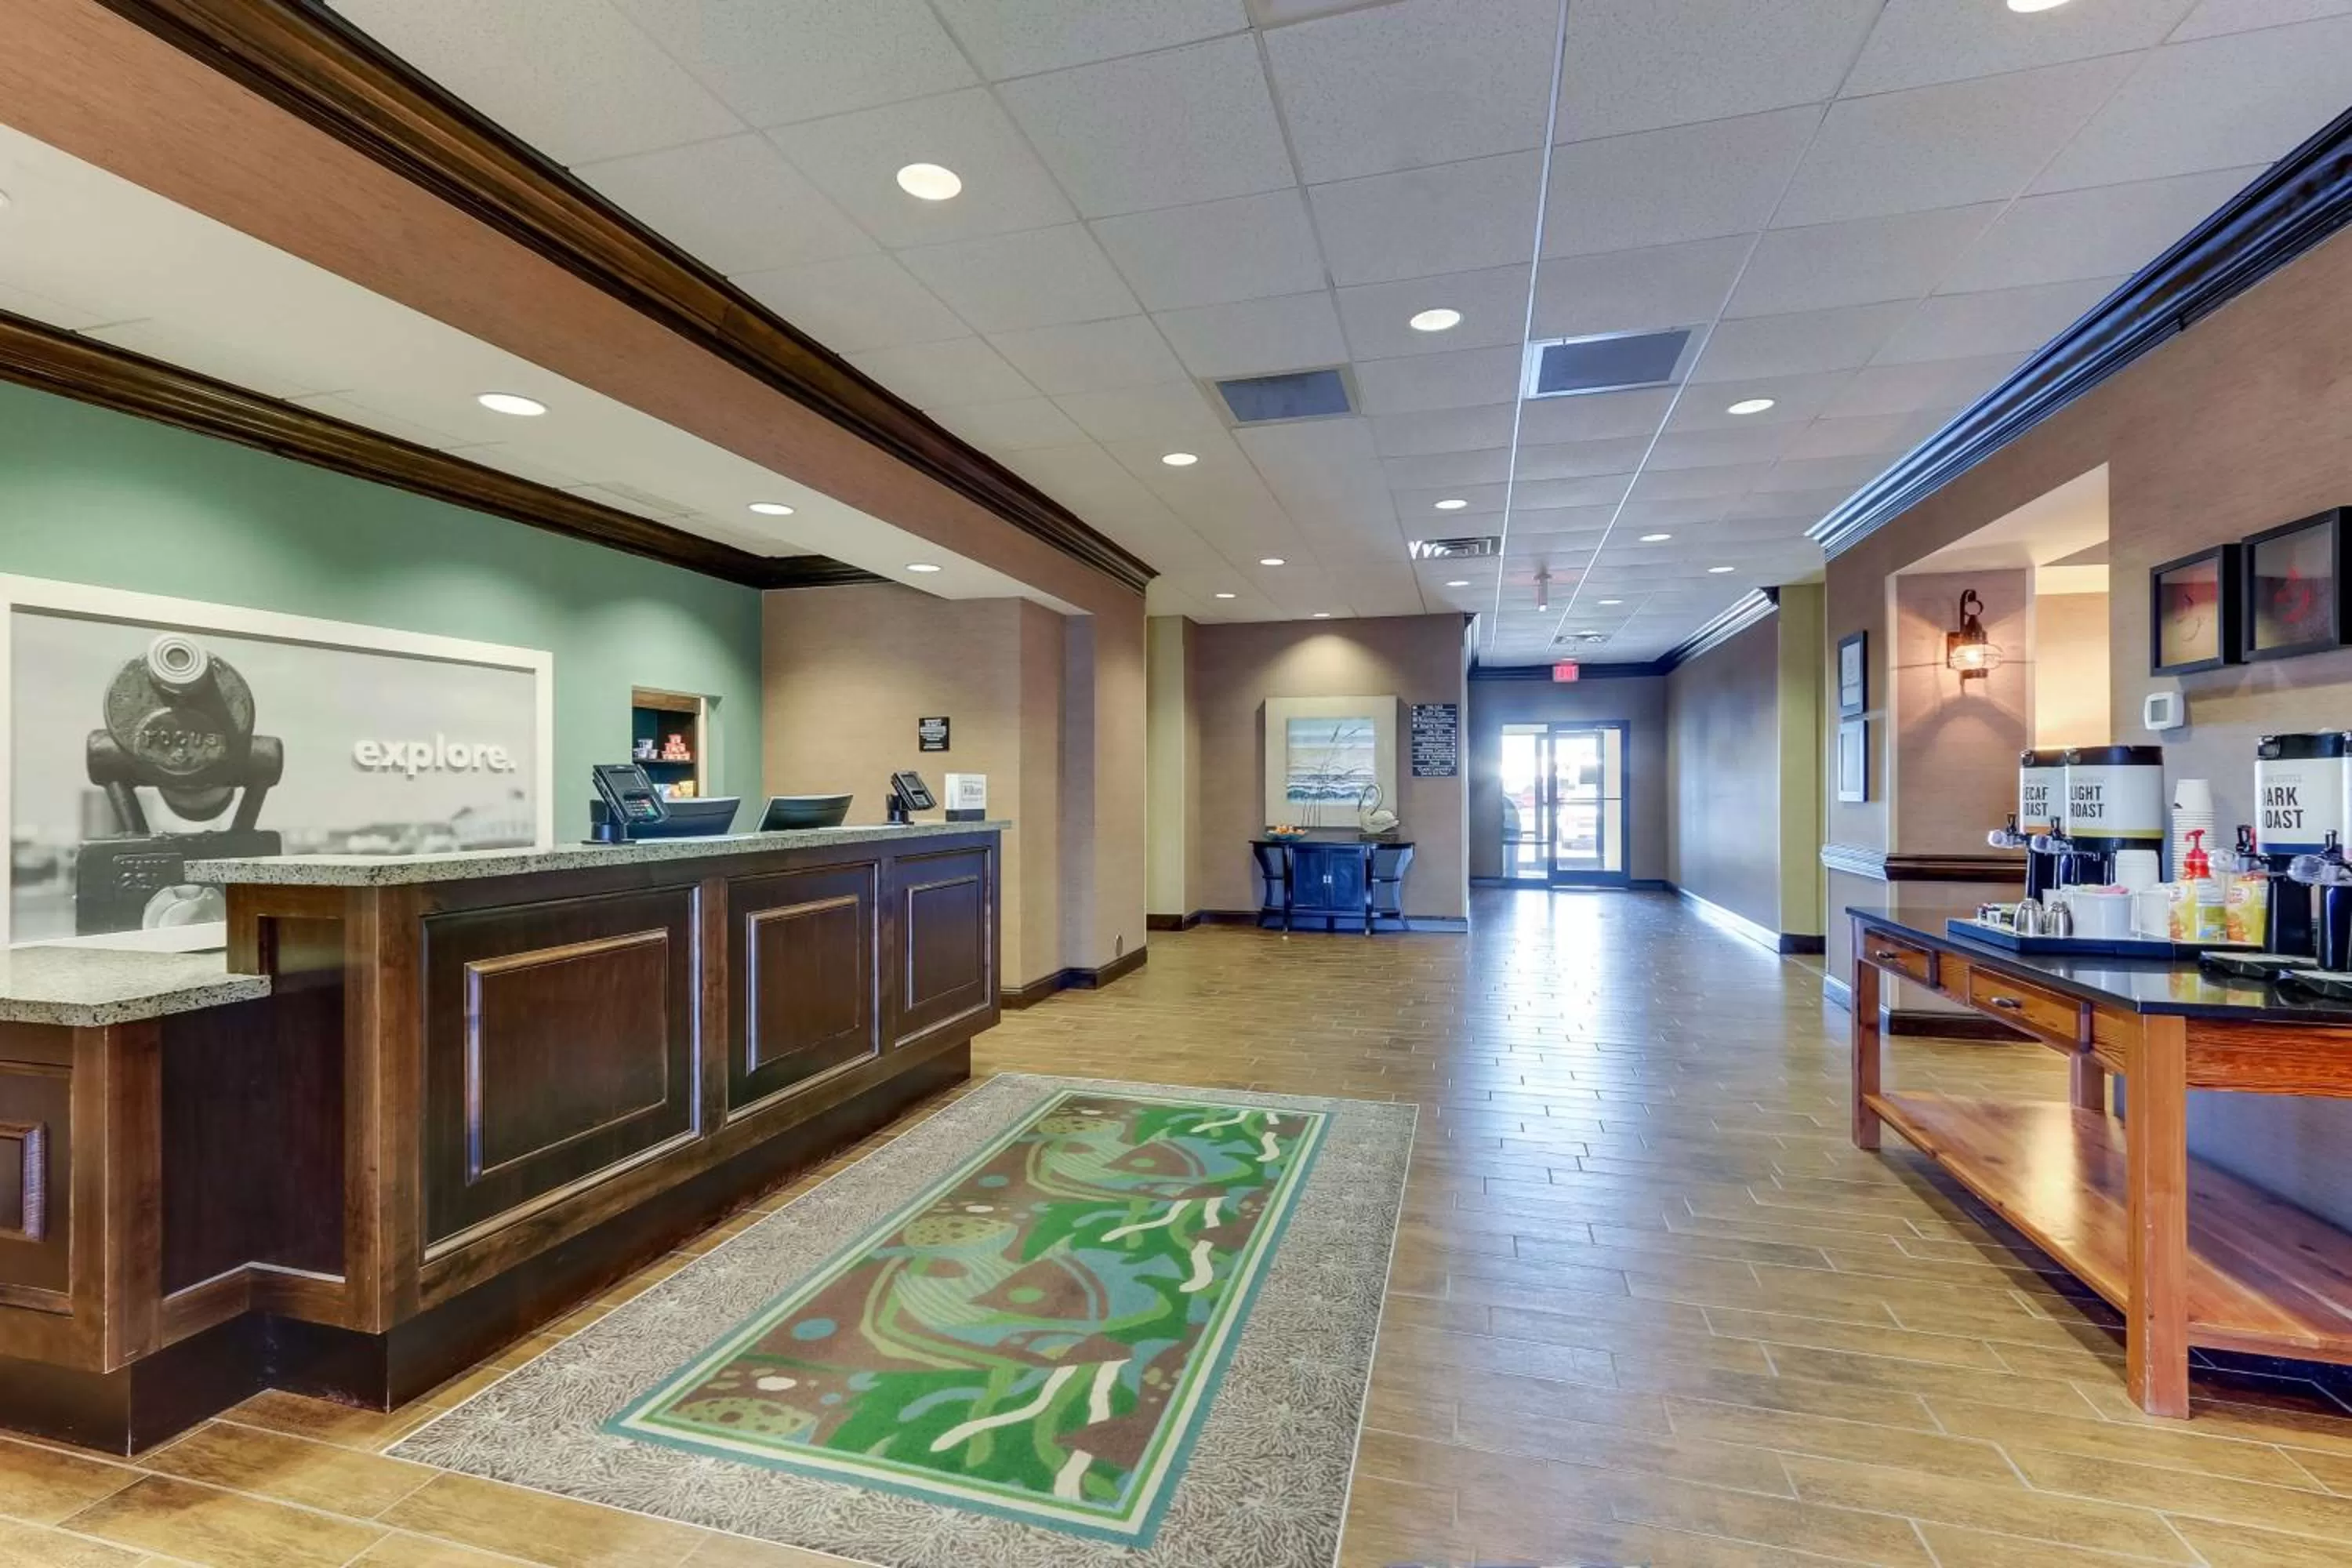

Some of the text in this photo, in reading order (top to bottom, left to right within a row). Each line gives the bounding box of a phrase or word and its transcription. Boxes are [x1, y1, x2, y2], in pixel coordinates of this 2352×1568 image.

[353, 731, 517, 779] explore.
[2024, 786, 2049, 800] ECAF
[2070, 786, 2102, 800] LIGHT
[2024, 802, 2049, 816] OAST
[2263, 809, 2304, 829] OAST
